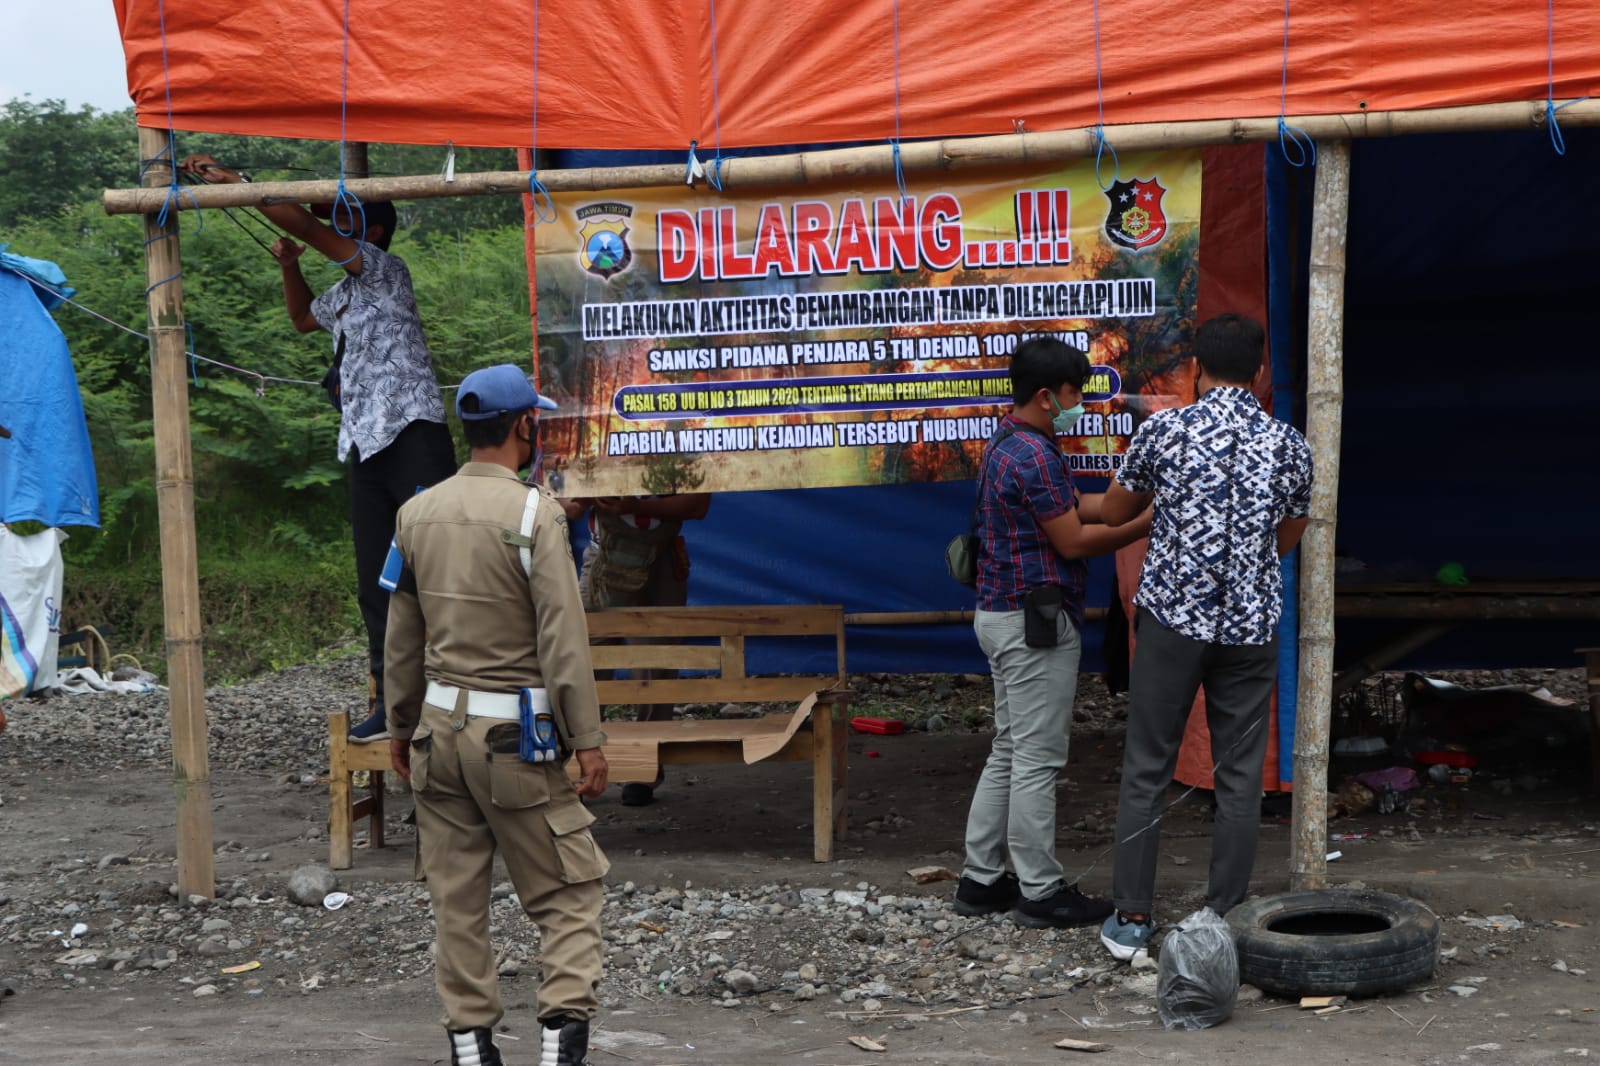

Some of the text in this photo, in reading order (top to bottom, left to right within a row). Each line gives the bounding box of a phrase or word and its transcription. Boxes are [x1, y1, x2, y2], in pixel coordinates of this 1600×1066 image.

[579, 205, 630, 218] JAWA TIMUR
[585, 281, 1154, 338] MELAKUKAN AKTIFITAS PENAMBANGAN TANPA DILENGKAPI IJIN
[649, 349, 717, 371] SANKSI
[721, 345, 789, 368] PIDANA
[792, 340, 871, 365] PENJARA
[873, 339, 886, 360] 5
[890, 338, 915, 360] TH
[918, 336, 980, 358] DENDA
[983, 333, 1018, 356] 100
[623, 393, 656, 412] PASAL
[656, 392, 677, 411] 158
[681, 391, 696, 410] UU
[698, 391, 709, 409] RI
[710, 390, 725, 409] NO
[726, 389, 734, 408] 3
[736, 388, 770, 407] TAHUN
[772, 387, 799, 406] 2020
[801, 385, 847, 404] TENTANG
[848, 383, 894, 402] TENTANG
[896, 379, 981, 400] PERTAMBANGAN
[608, 431, 677, 456] APABILA
[678, 427, 754, 452] MENEMUI
[757, 423, 835, 450] KEJADIAN
[836, 420, 919, 446] TERSEBUT
[922, 416, 997, 442] HUBUNGI
[1107, 412, 1133, 436] 110
